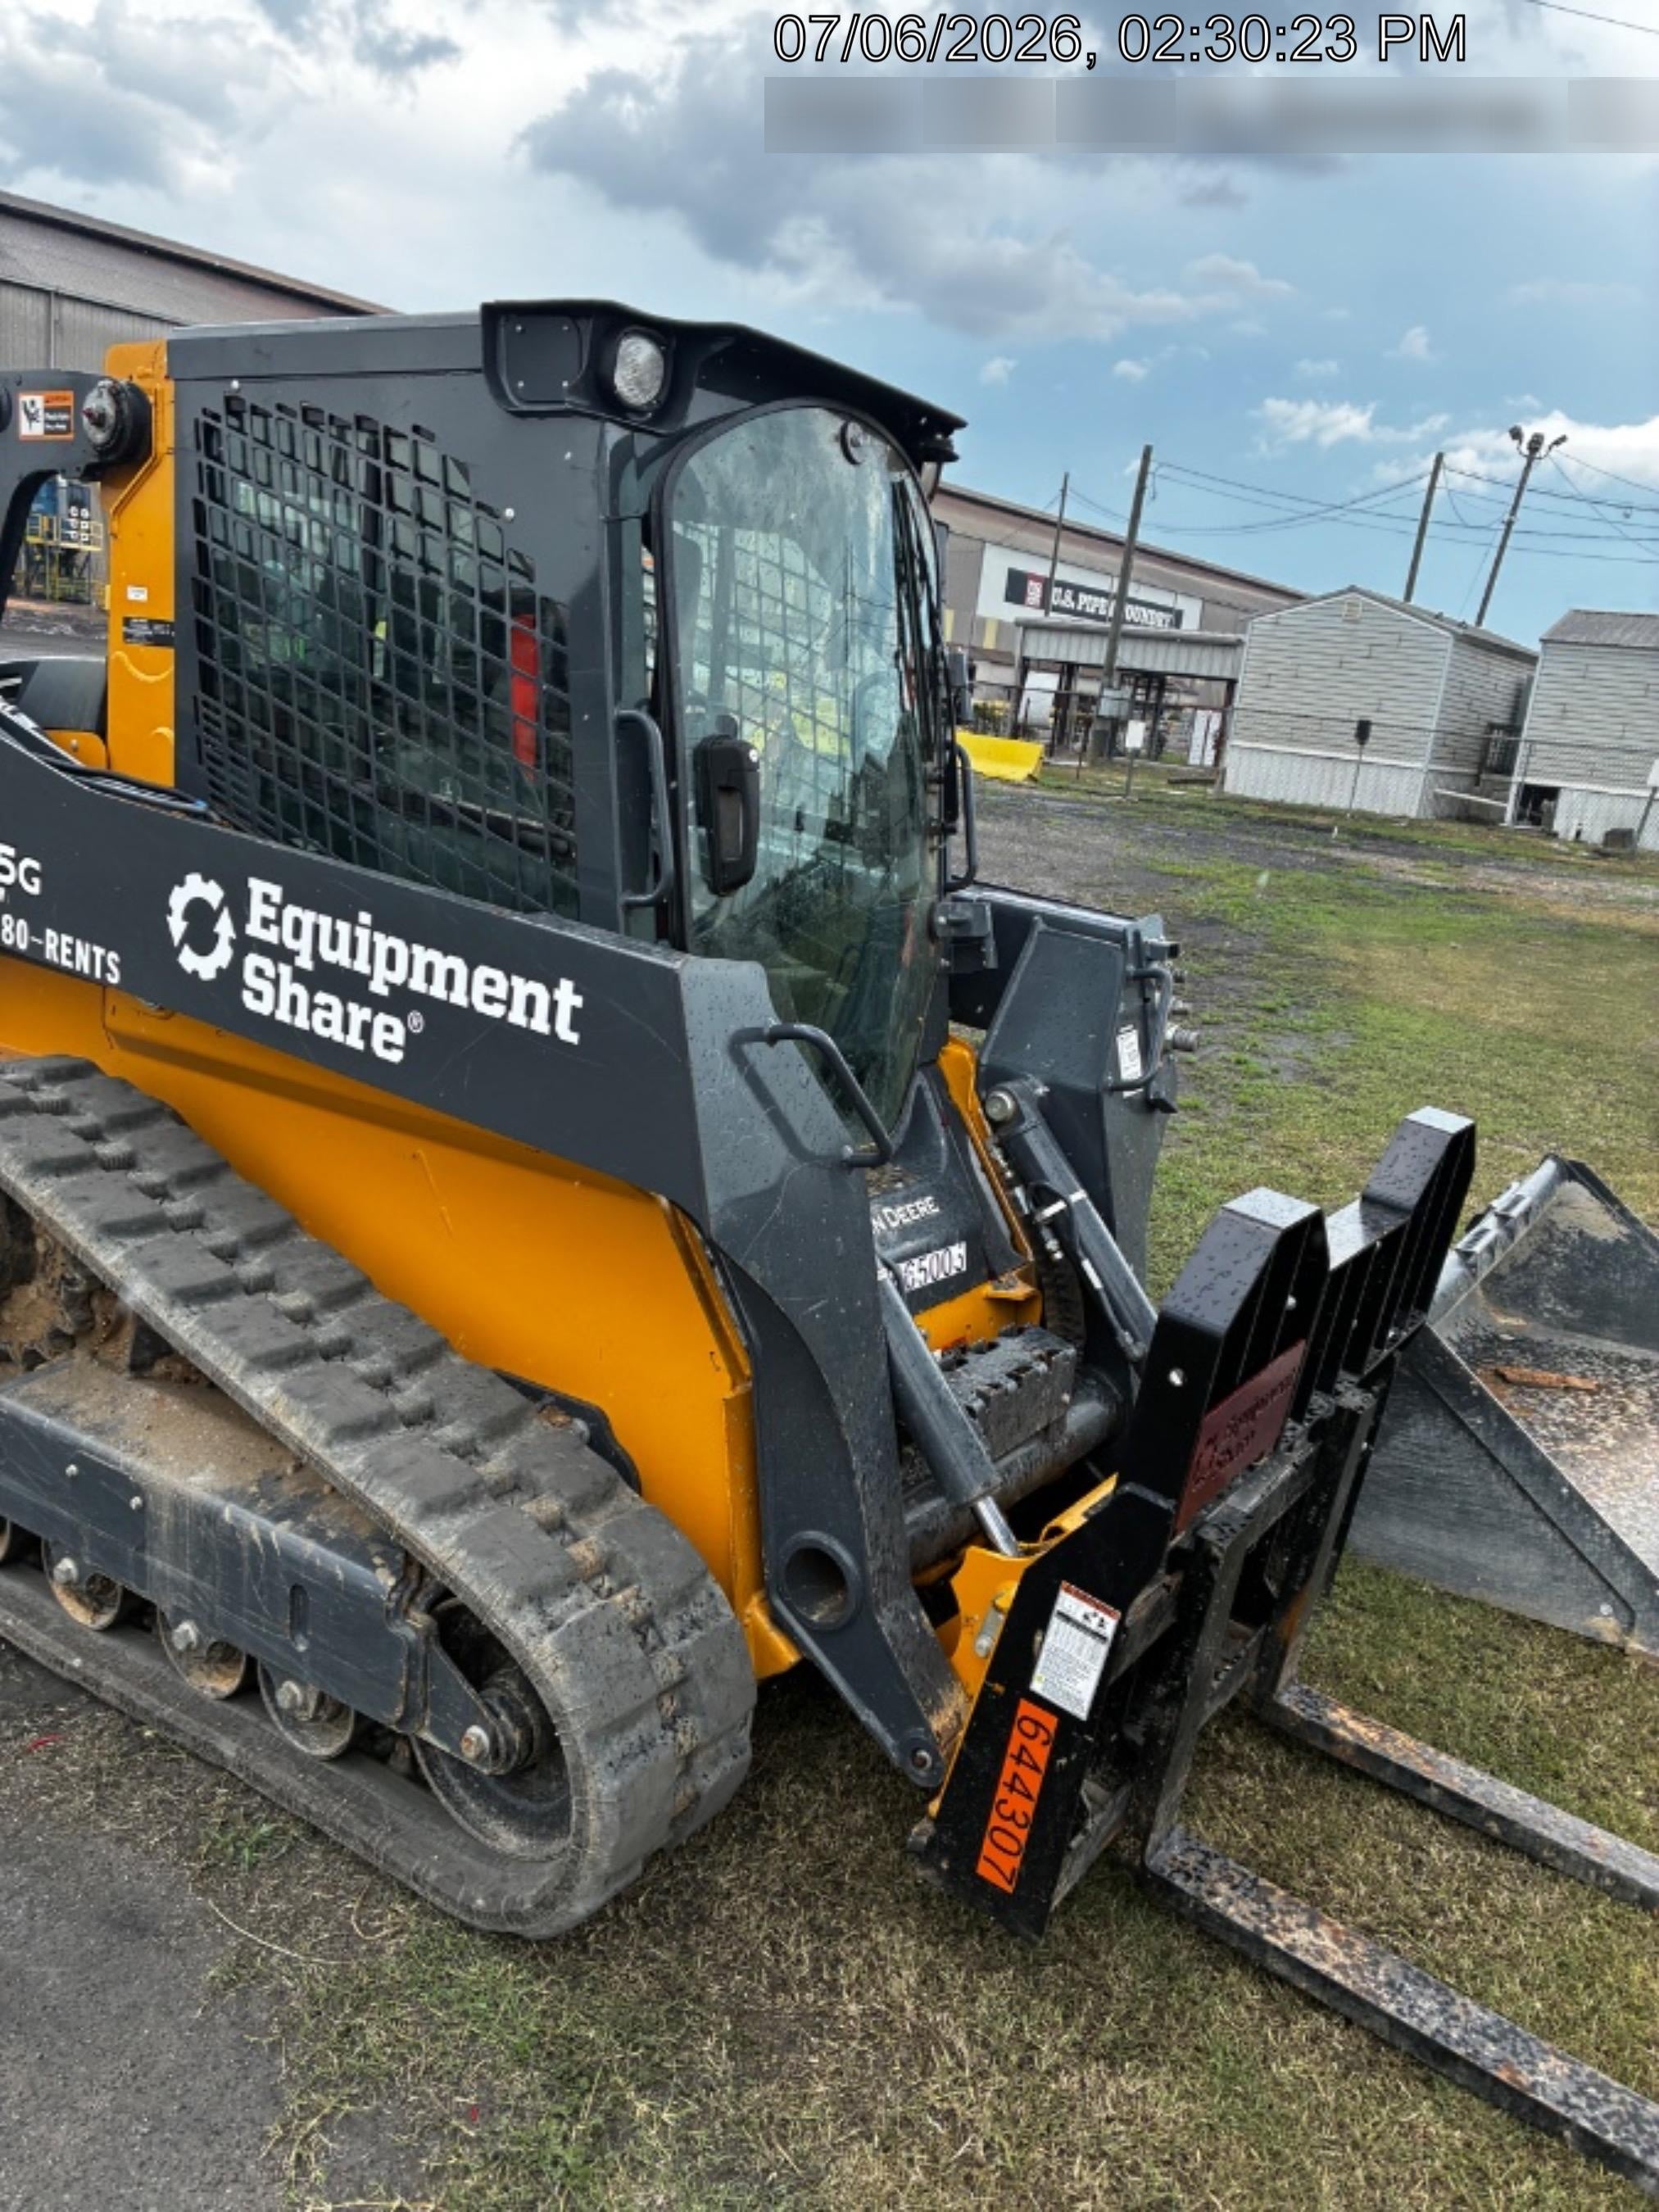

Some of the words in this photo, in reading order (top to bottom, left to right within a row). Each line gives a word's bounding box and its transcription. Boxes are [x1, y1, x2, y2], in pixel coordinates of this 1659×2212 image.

[247, 877, 584, 1045] Equipment
[882, 1195, 940, 1227] DEERE
[982, 1714, 1051, 1887] 644307
